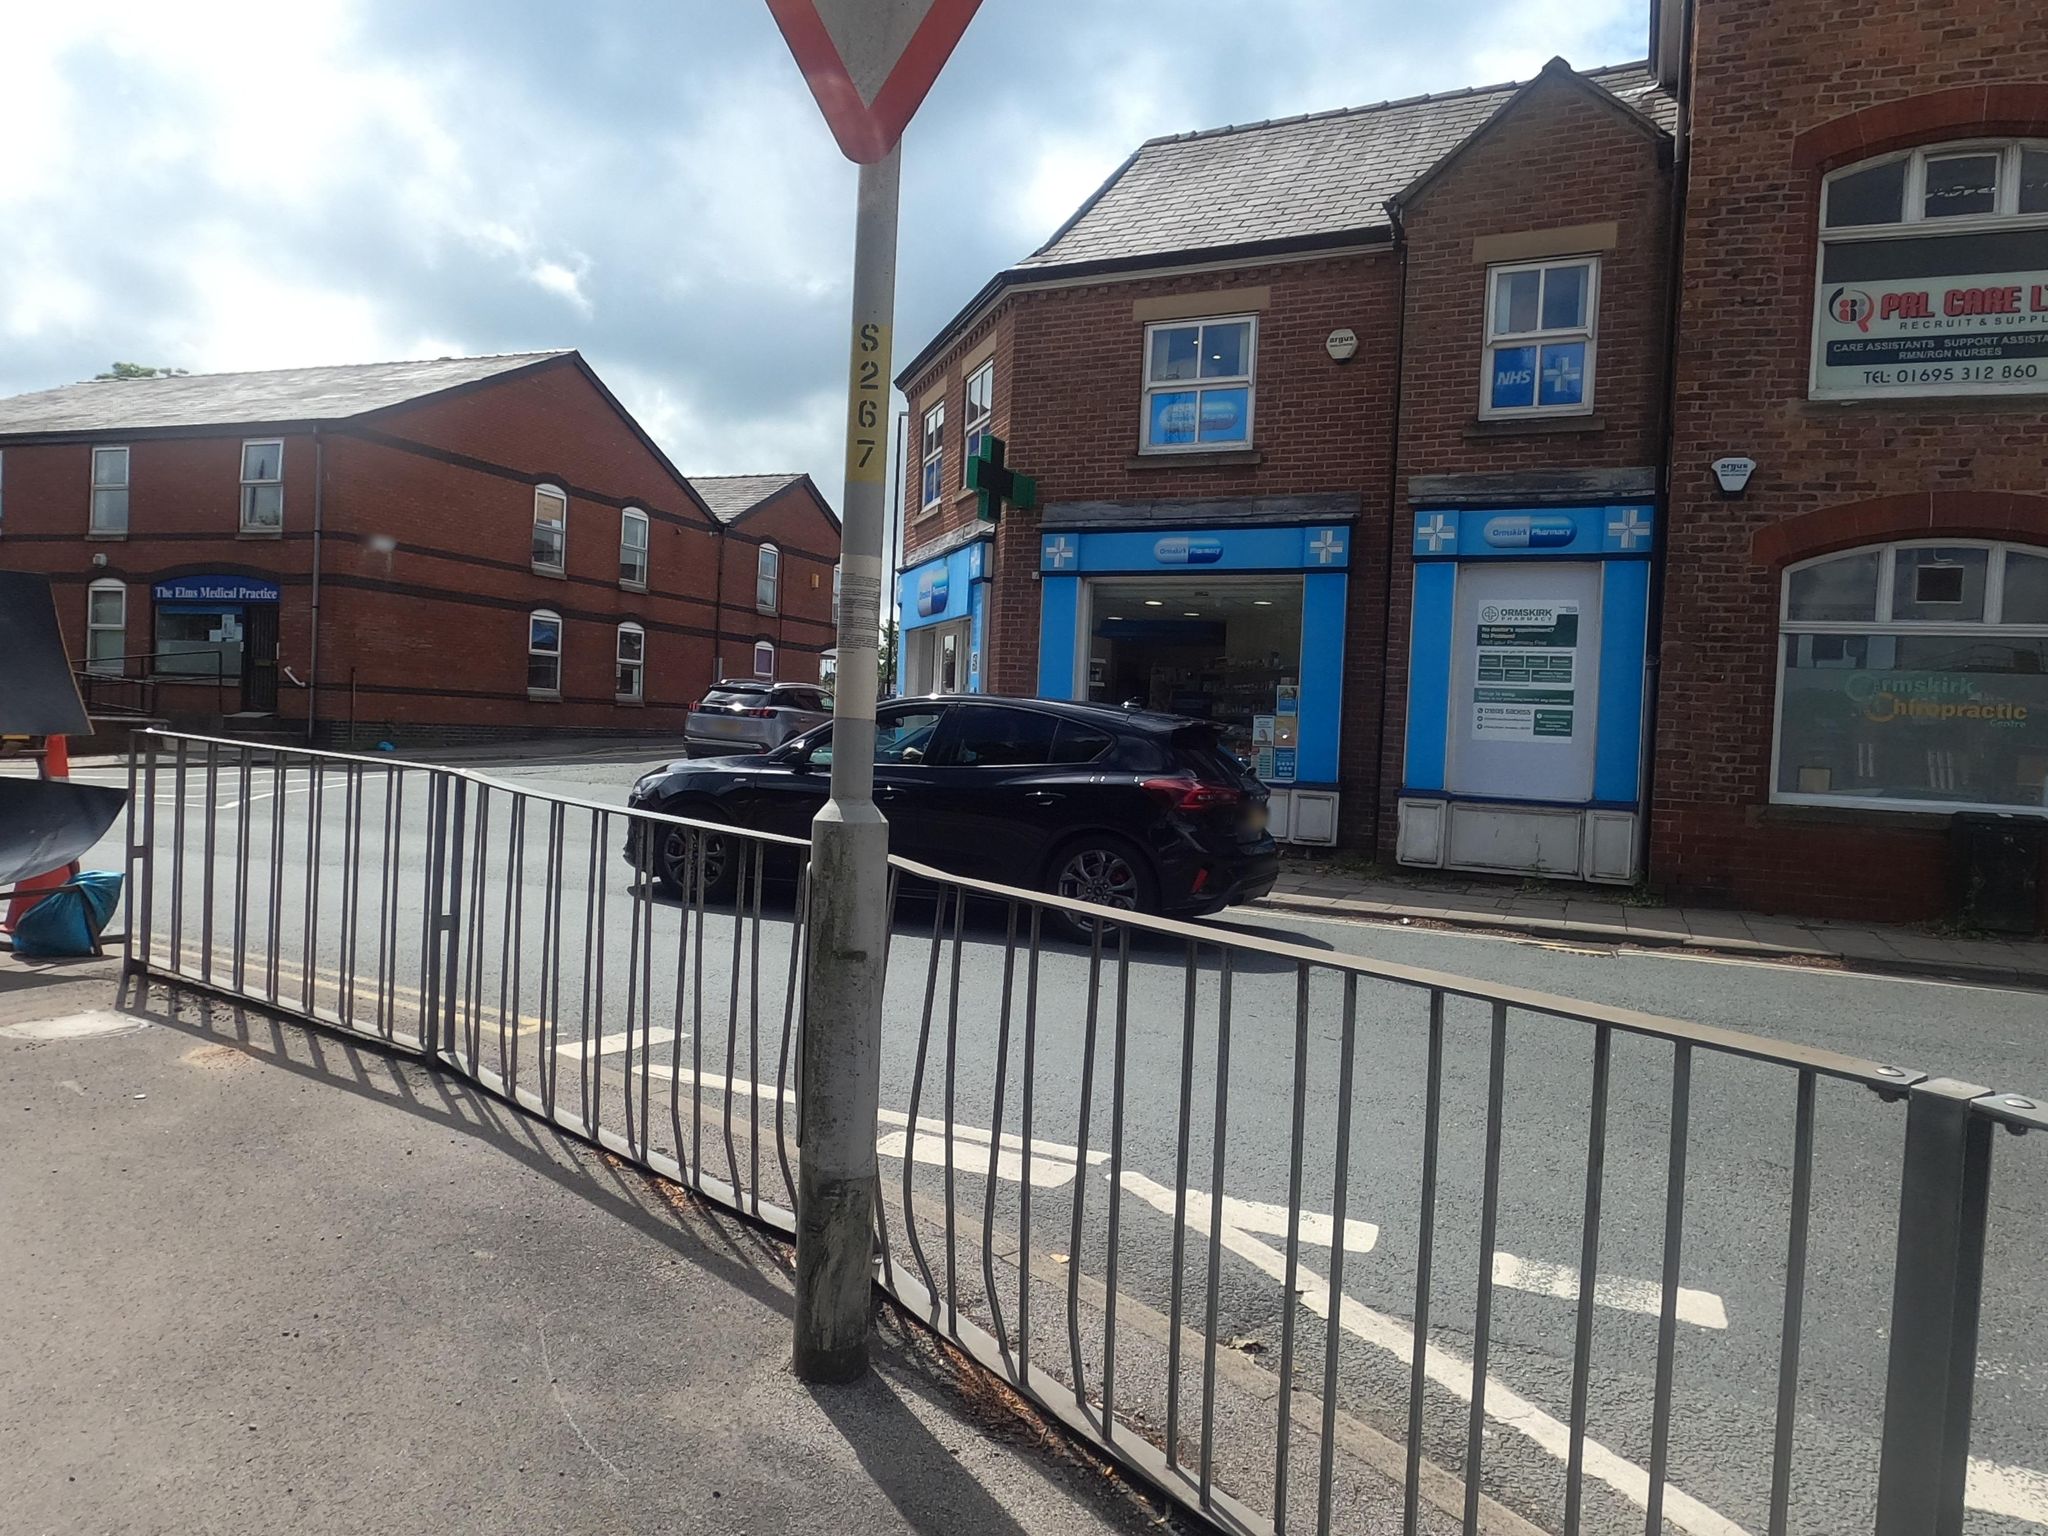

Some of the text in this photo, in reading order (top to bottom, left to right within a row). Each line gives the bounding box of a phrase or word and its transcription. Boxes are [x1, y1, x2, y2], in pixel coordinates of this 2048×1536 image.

[1880, 285, 2048, 320] PRL CARE L
[1899, 319, 1972, 330] RECRUIT
[1979, 318, 1987, 326] &
[1833, 343, 1864, 352] CARE
[1866, 340, 1935, 351] ASSISTANTS
[1944, 336, 1999, 347] SUPPORT
[1954, 347, 2002, 358] NURSES
[1496, 370, 1531, 386] NHS
[1863, 364, 2038, 384] TEL: 01695 312 860
[857, 324, 879, 468] S267
[1492, 528, 1572, 537] Ormskirk Pharmacy
[155, 587, 278, 599] The Elms Medical Practice
[1500, 608, 1553, 617] ORMSKIRK
[1864, 691, 2028, 722] Chiropractic
